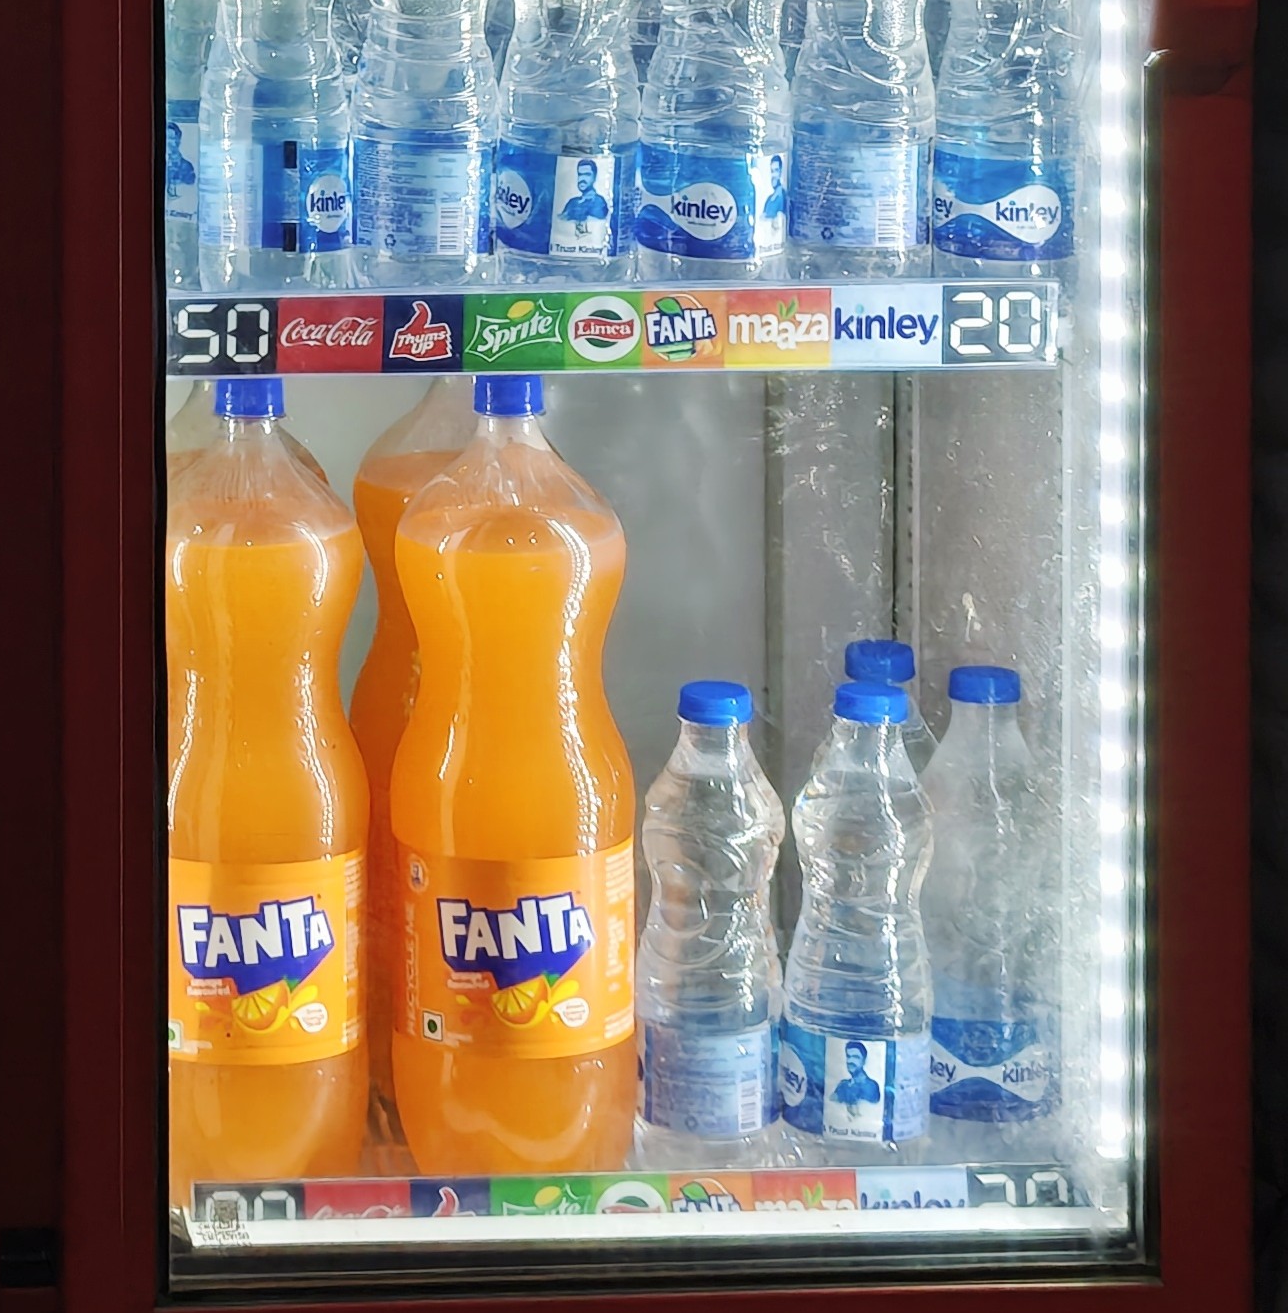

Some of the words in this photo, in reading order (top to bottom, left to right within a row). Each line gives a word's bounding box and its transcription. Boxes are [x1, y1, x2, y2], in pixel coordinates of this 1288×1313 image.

[310, 190, 345, 212] kinle
[671, 195, 733, 225] kinley
[177, 303, 269, 362] 50
[280, 316, 376, 347] Coca-Cola
[477, 313, 553, 352] Sprite
[577, 321, 633, 336] Limca
[646, 308, 715, 344] FANTA
[730, 312, 828, 350] maaza
[834, 307, 937, 345] kinley
[949, 291, 1040, 355] 20
[180, 896, 331, 967] FANTA
[440, 894, 593, 961] FANTA
